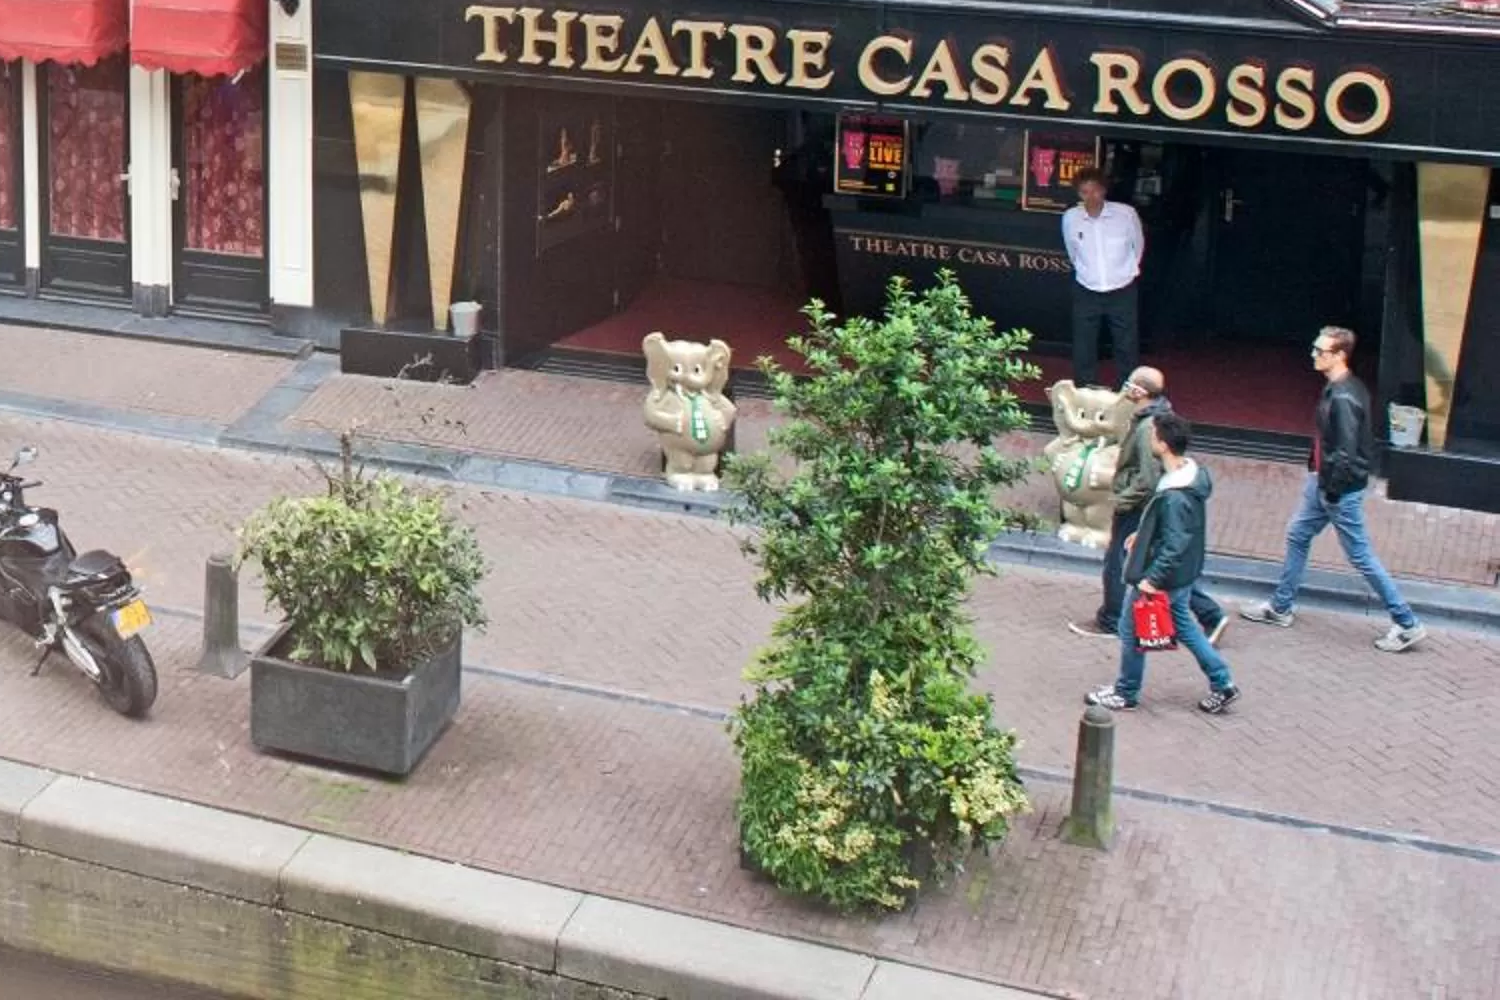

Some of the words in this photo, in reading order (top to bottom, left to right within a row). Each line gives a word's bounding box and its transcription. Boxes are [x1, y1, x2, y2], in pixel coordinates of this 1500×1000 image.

[465, 5, 834, 89] THEATRE
[857, 35, 1069, 111] CASA
[1089, 51, 1392, 136] ROSSO
[869, 147, 902, 164] LIVE
[851, 235, 952, 261] THEATRE
[957, 247, 1011, 268] CASA
[1018, 253, 1072, 273] ROSS
